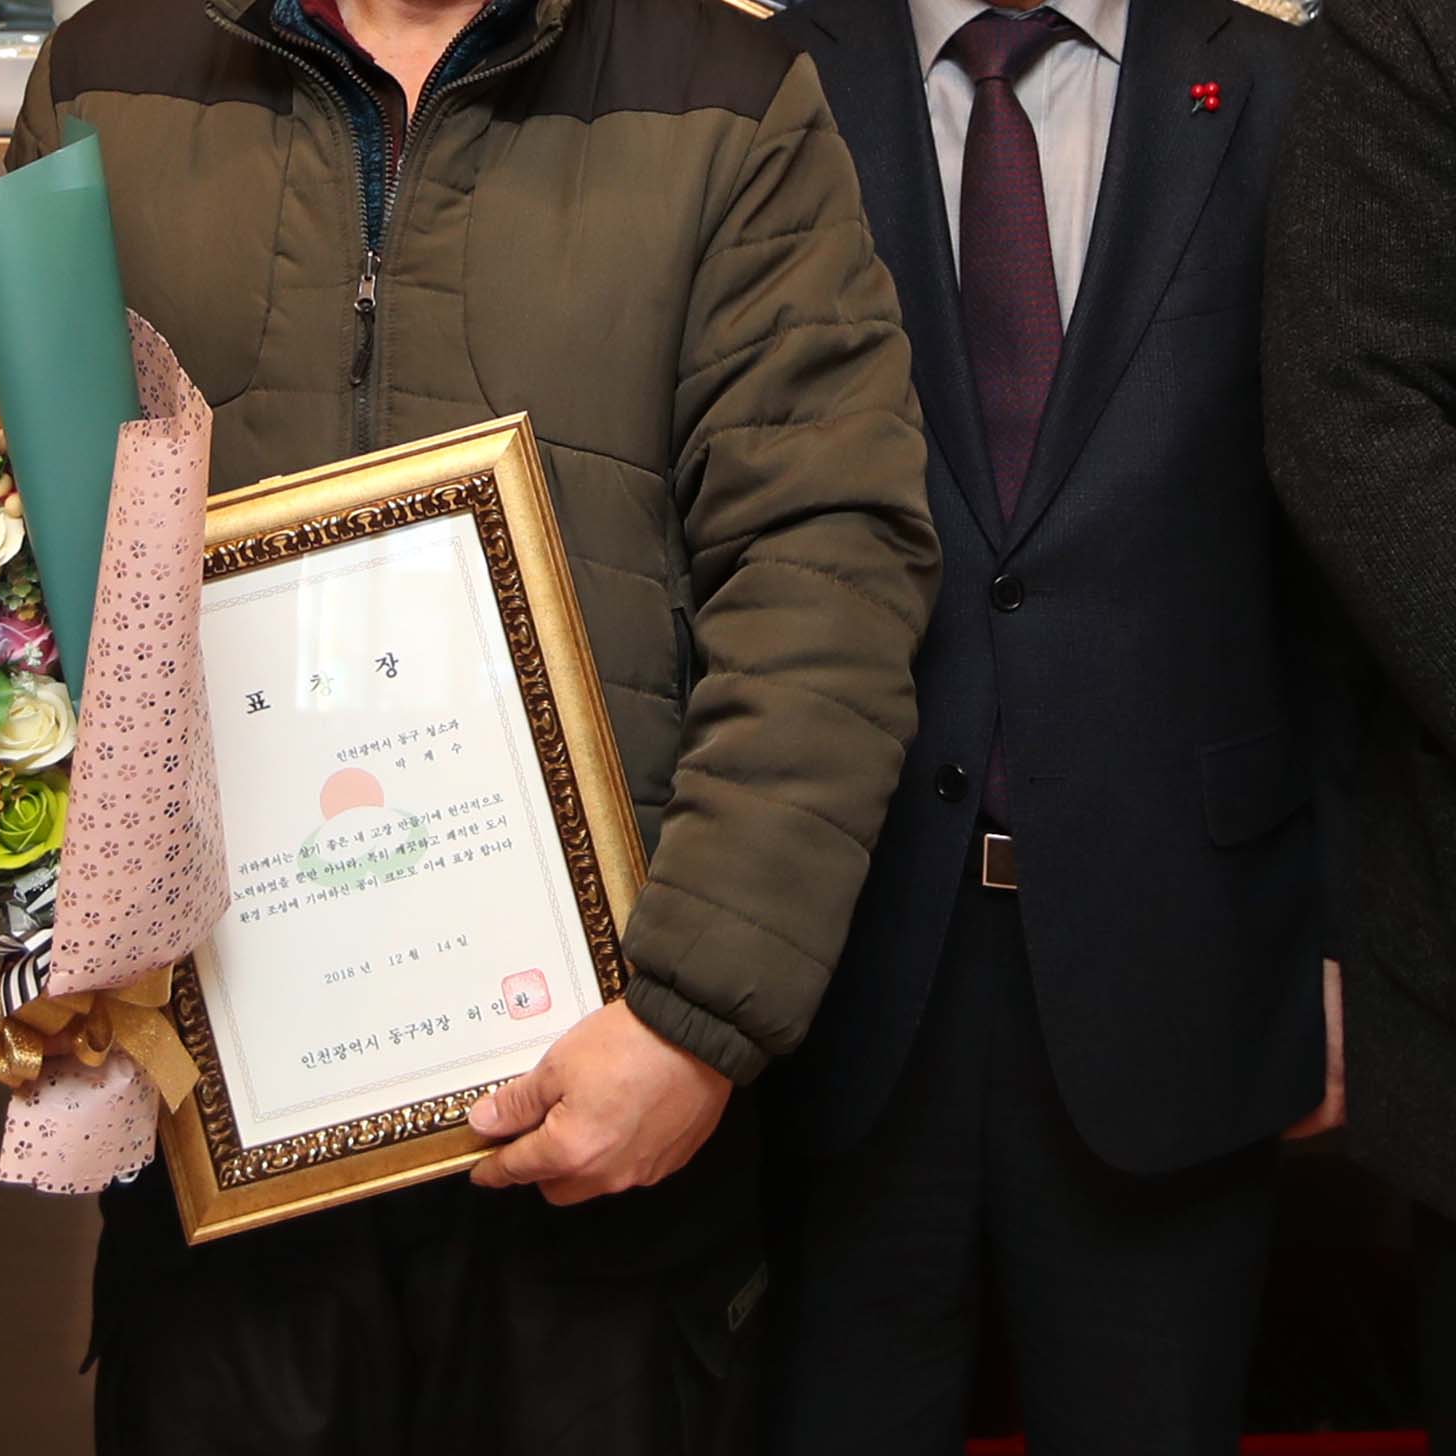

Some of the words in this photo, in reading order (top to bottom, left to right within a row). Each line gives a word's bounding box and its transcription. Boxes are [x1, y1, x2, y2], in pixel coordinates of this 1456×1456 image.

[244, 690, 272, 715] 표
[374, 651, 400, 679] 장
[323, 966, 356, 985] 2018
[388, 952, 404, 967] 12
[435, 939, 452, 954] 14
[300, 1033, 381, 1071] 인천광역시
[388, 1013, 452, 1047] 동구청장
